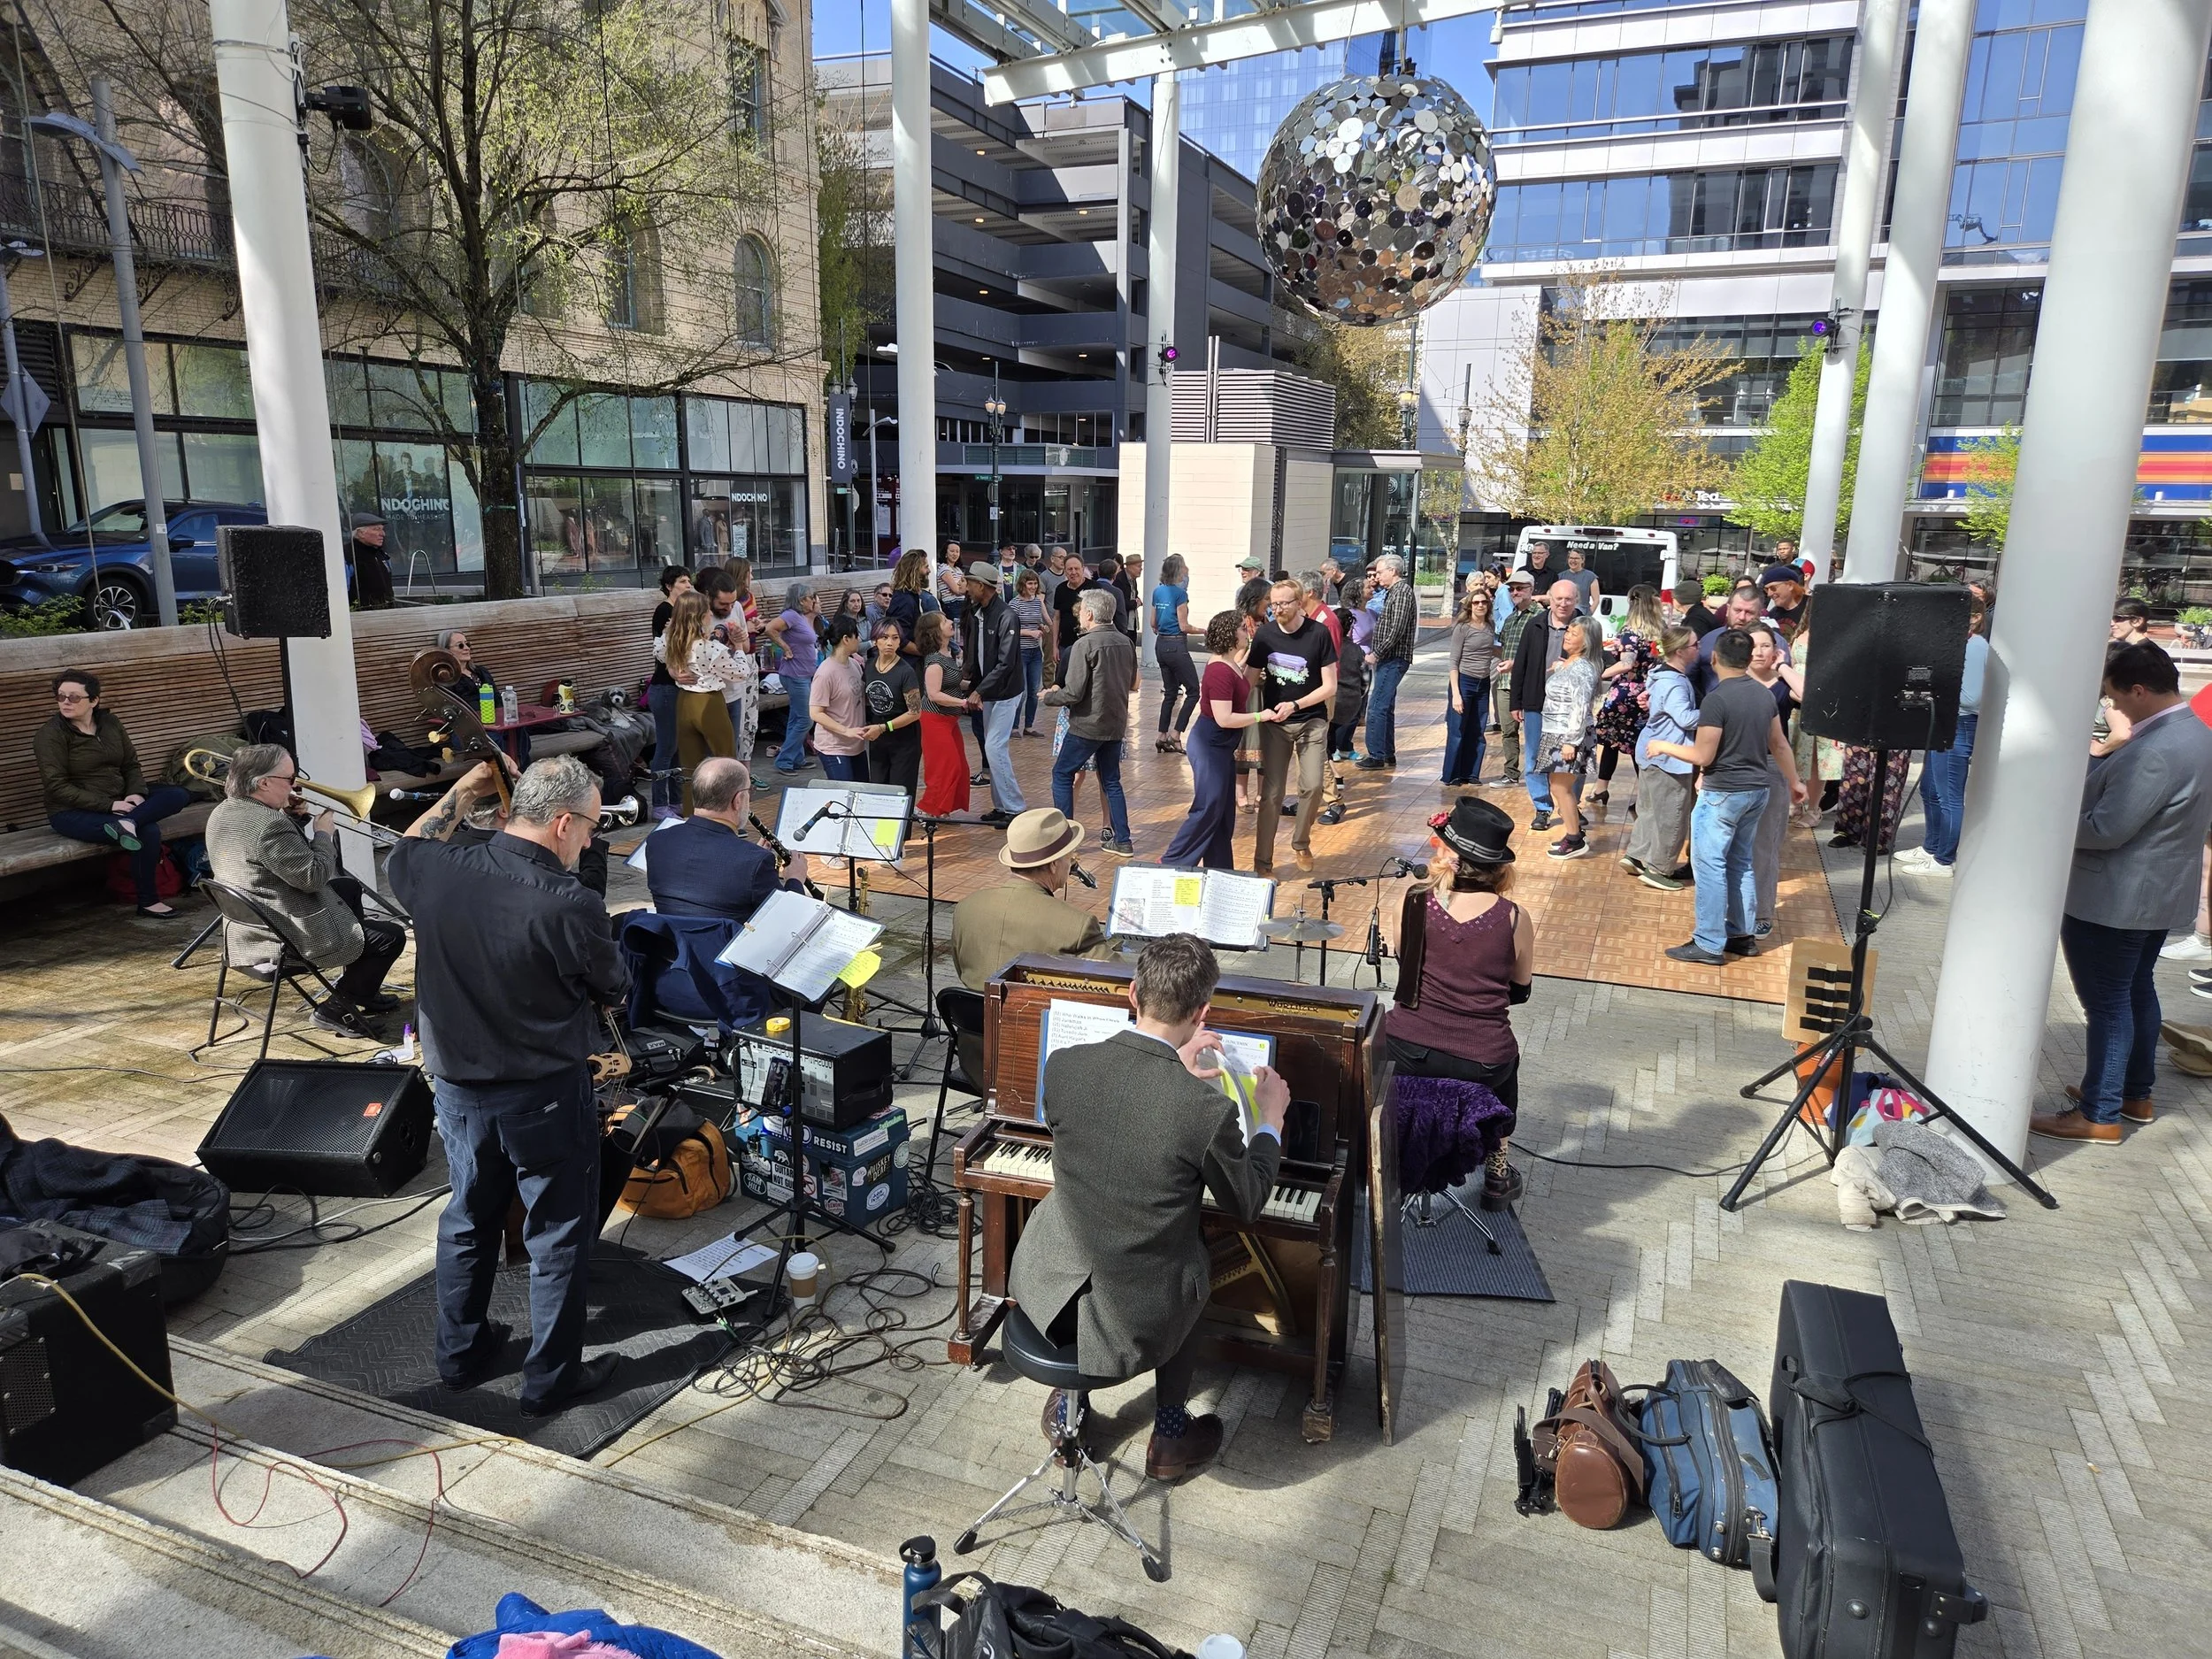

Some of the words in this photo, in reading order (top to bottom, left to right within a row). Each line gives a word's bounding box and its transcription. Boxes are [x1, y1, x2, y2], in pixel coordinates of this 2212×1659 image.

[836, 408, 846, 470] INDOCHINO
[381, 498, 449, 511] NDOCHINO
[731, 493, 768, 503] NDOCHNO
[1598, 541, 1619, 550] Van?
[774, 1163, 794, 1178] GUITAR
[747, 1173, 762, 1186] SAM
[748, 1180, 761, 1194] HILL
